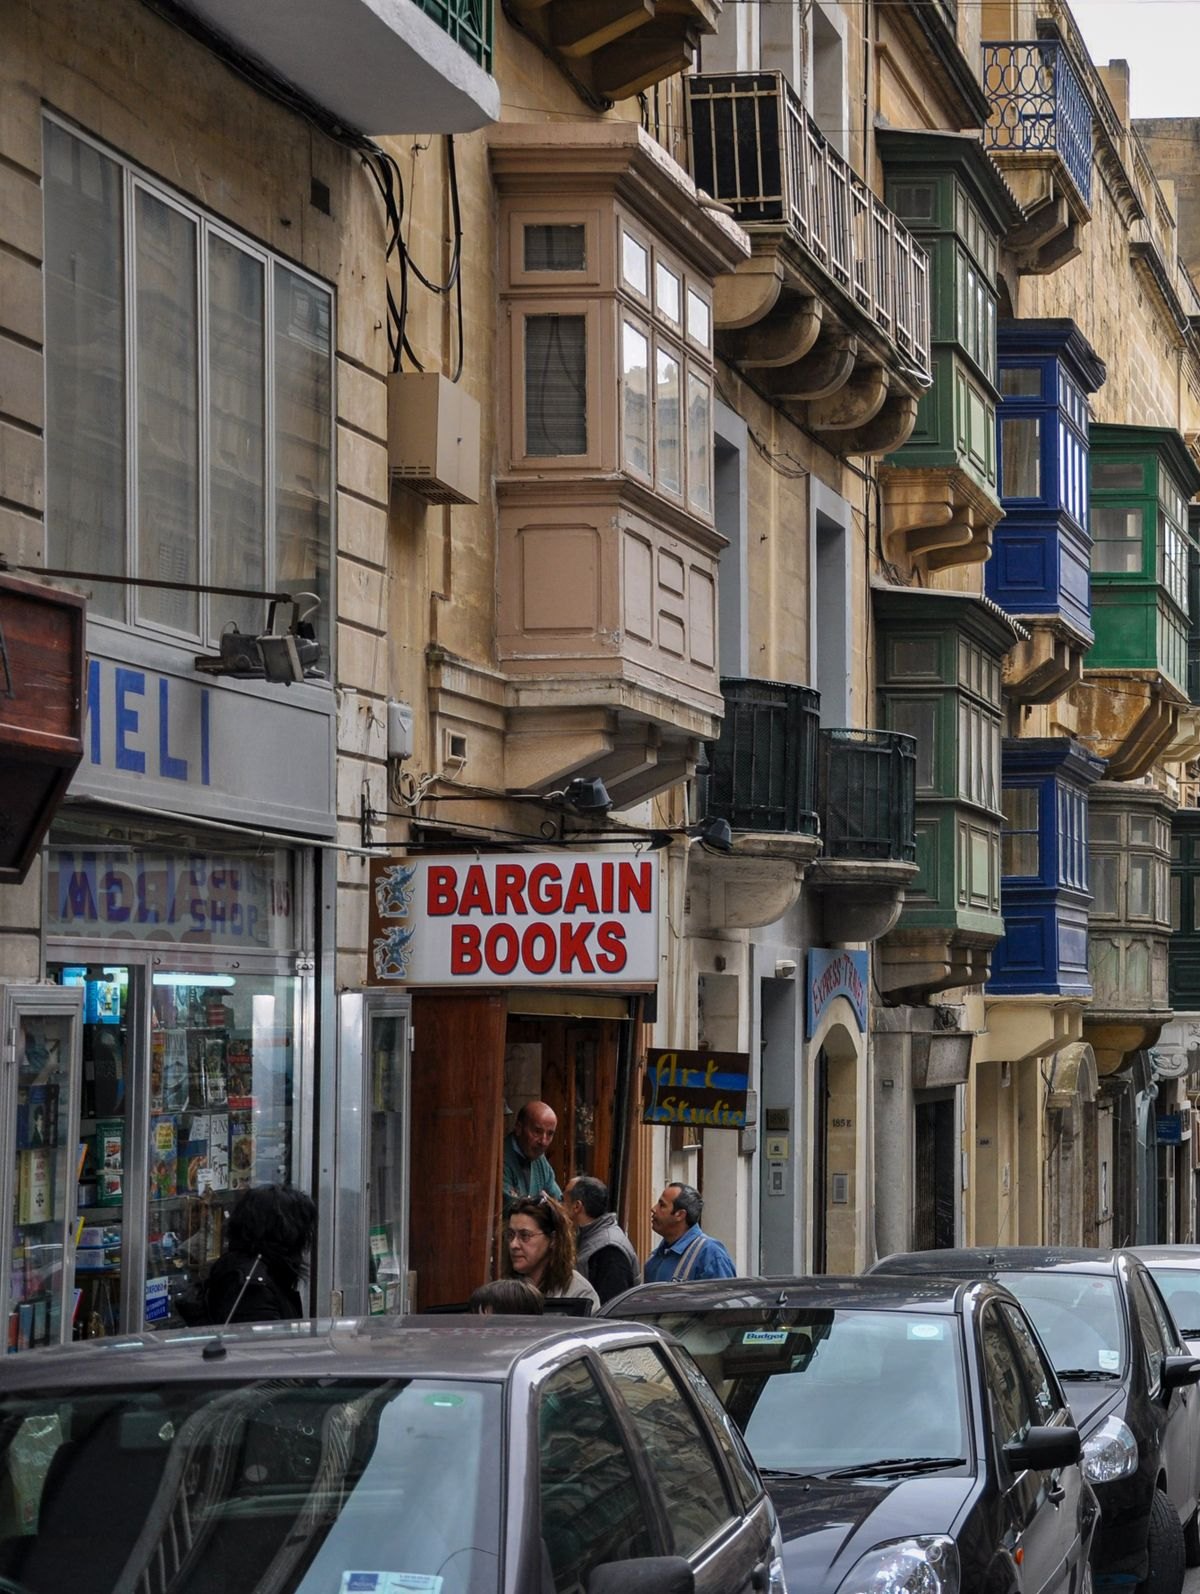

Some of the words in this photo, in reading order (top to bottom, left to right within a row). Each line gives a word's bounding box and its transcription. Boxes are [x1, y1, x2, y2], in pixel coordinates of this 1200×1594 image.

[427, 862, 652, 916] BARGAIN
[450, 921, 627, 975] BOOKS
[655, 1053, 719, 1089] Art
[661, 1096, 745, 1125] Studio
